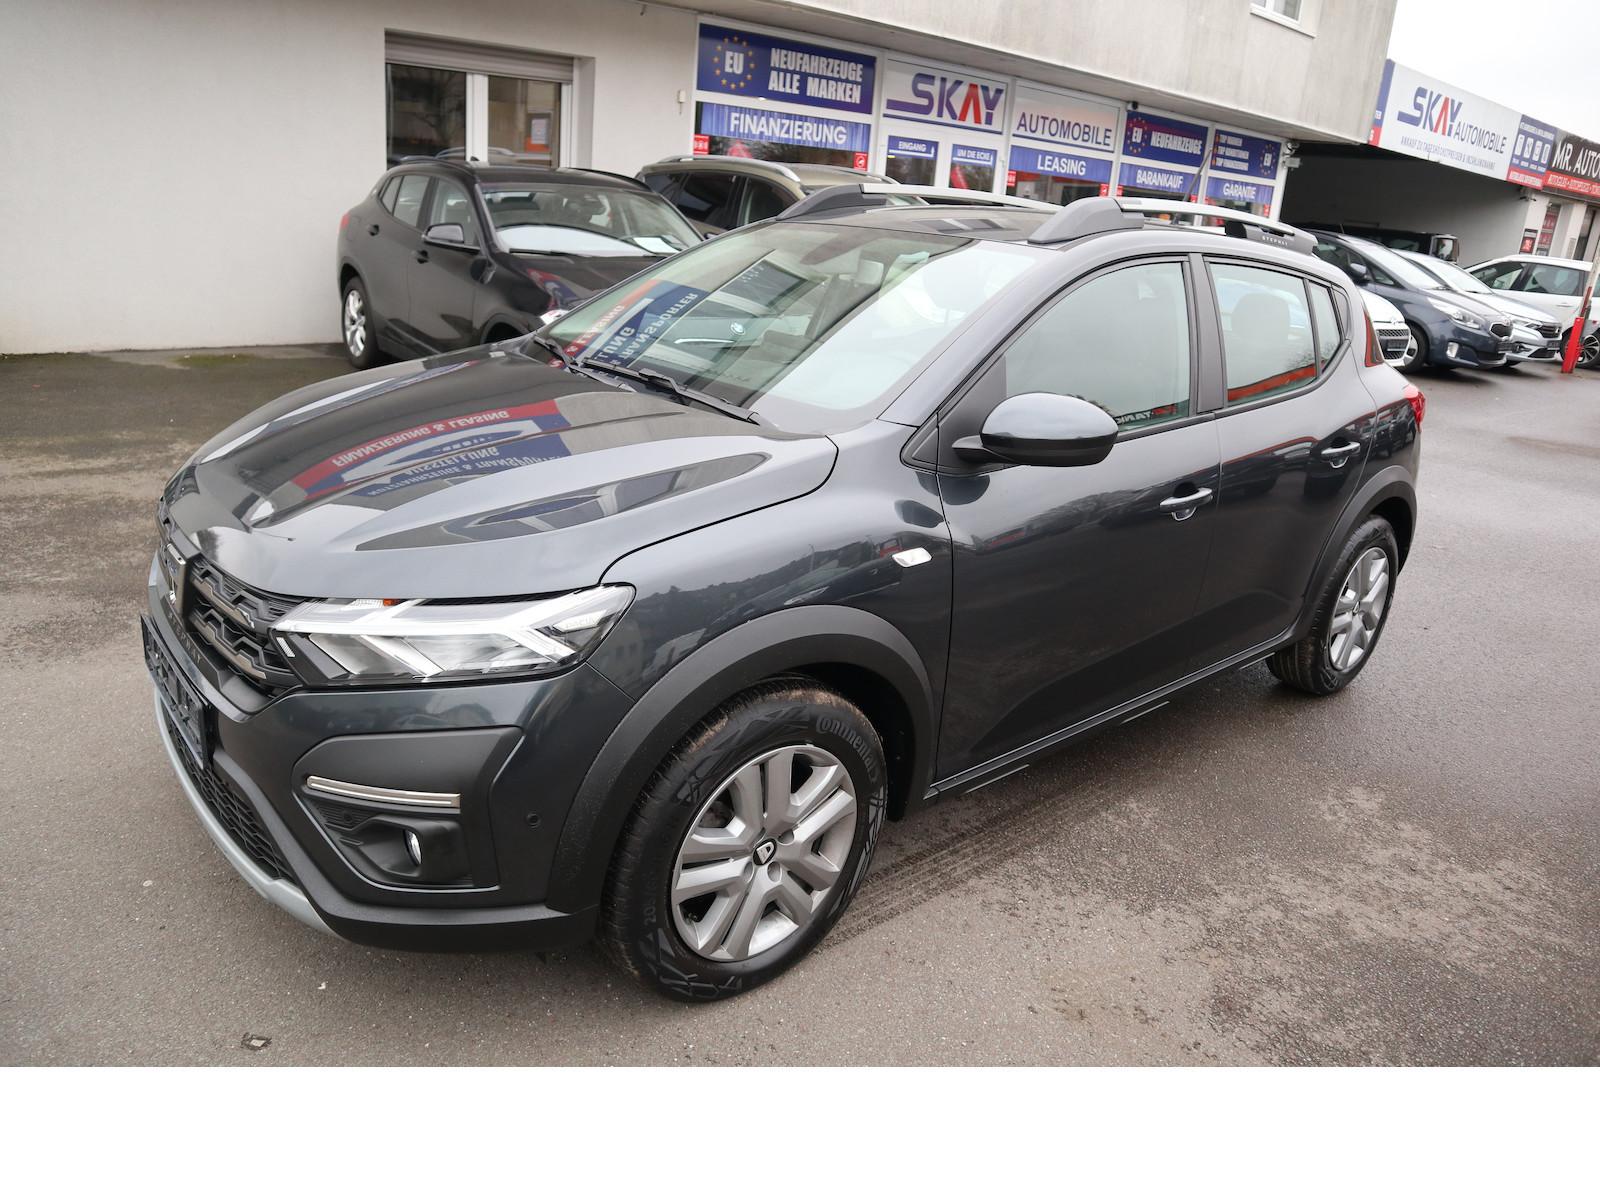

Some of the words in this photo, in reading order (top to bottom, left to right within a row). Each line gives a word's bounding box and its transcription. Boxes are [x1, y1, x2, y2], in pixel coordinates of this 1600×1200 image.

[724, 51, 744, 75] EU
[770, 48, 863, 82] NEUFAHRZEUGE
[768, 74, 800, 95] ALLE
[807, 77, 862, 104] MARKEN
[886, 72, 1004, 126] SKAY
[1397, 86, 1463, 138] SKAY
[730, 112, 848, 145] FINANZIERUNG
[1017, 112, 1113, 147] AUTOMOBILE
[1132, 127, 1143, 143] EU
[1150, 131, 1202, 155] NEUFAHRZEUGE
[1453, 120, 1507, 155] AUTOMOBILE
[898, 141, 927, 152] EINGANG
[1552, 141, 1574, 172] MR.
[1037, 154, 1087, 176] LEASING
[1136, 170, 1184, 189] BARANKAUF
[1223, 183, 1257, 199] GARANTIE
